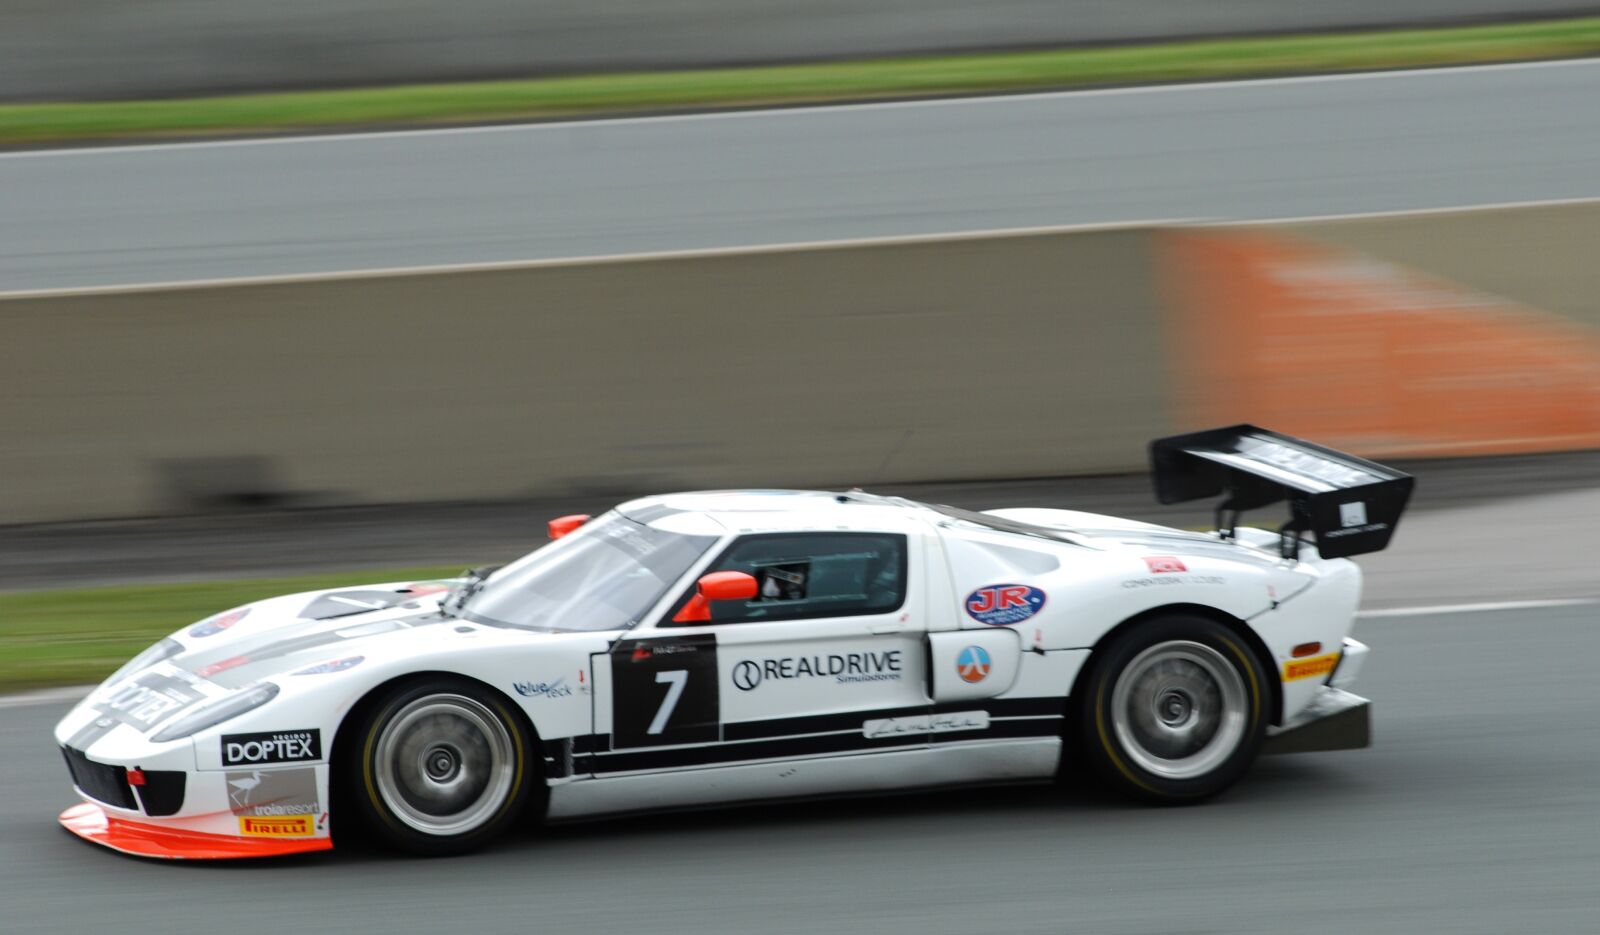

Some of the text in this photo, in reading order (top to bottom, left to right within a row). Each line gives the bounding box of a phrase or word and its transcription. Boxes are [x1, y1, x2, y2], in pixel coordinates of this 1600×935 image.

[969, 586, 1032, 613] JR
[763, 650, 902, 680] REALDRIVE
[646, 669, 689, 735] 7
[227, 738, 314, 762] DOPTEX
[244, 818, 306, 833] PIRELLI
